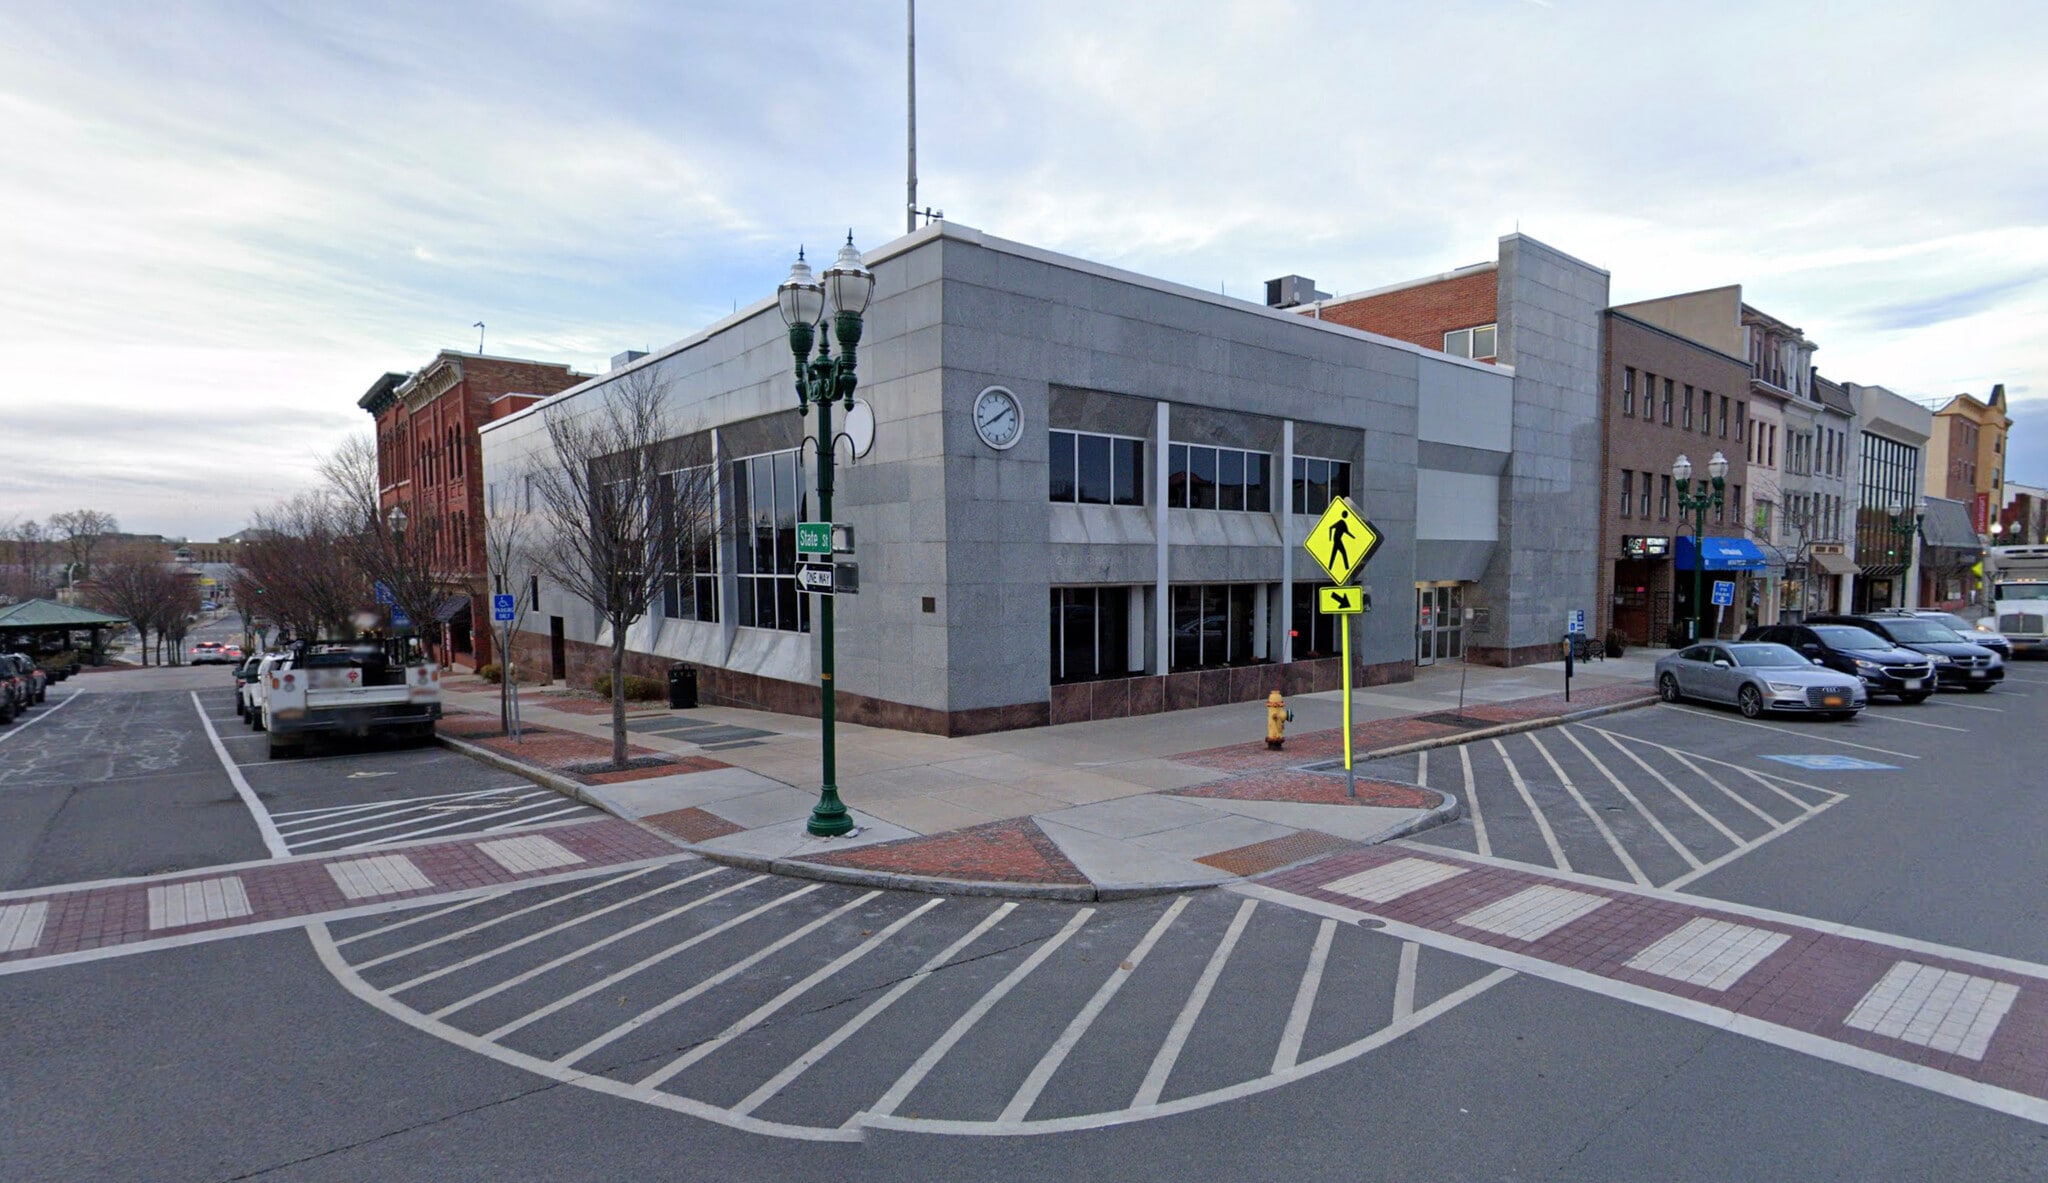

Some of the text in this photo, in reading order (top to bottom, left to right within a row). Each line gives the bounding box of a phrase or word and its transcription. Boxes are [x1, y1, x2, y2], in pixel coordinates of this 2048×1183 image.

[800, 529, 829, 547] State St
[807, 571, 830, 585] ONE WAY
